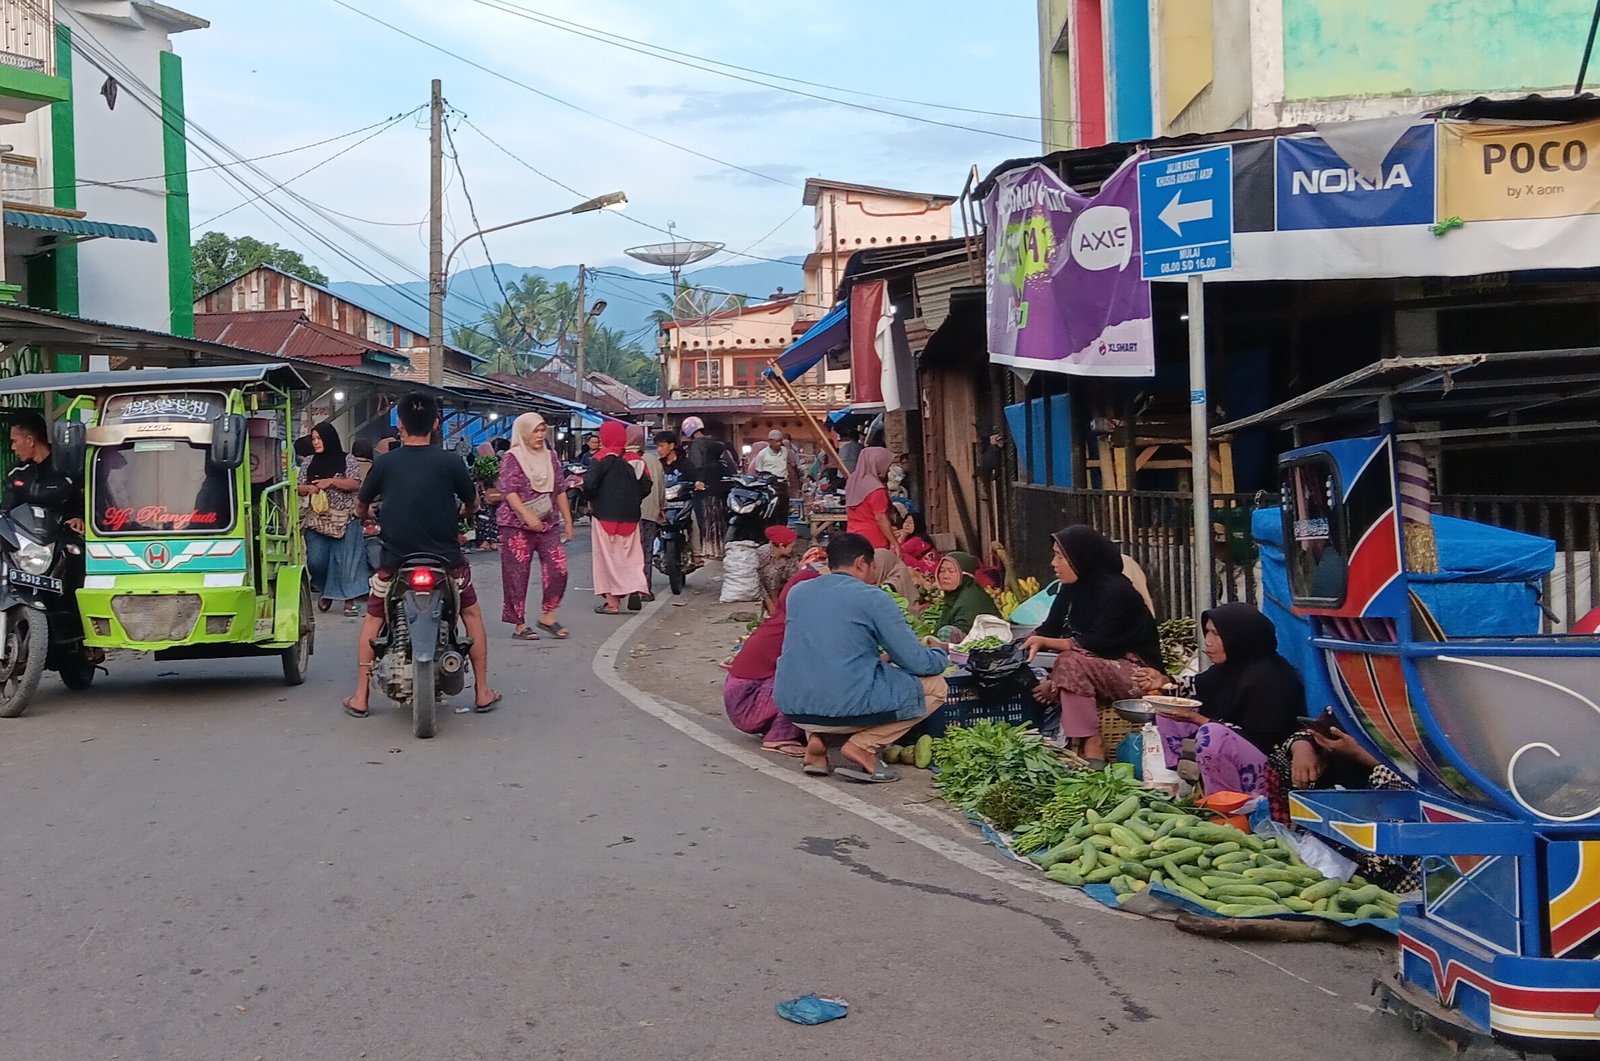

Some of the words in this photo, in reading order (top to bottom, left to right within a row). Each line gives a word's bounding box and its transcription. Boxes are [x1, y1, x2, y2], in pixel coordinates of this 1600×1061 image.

[1482, 139, 1588, 175] POCO
[1292, 163, 1413, 195] NOKIA
[1506, 185, 1522, 199] by
[1080, 226, 1127, 252] AXIS
[1160, 261, 1181, 273] 08.00
[1195, 256, 1216, 270] 16.00
